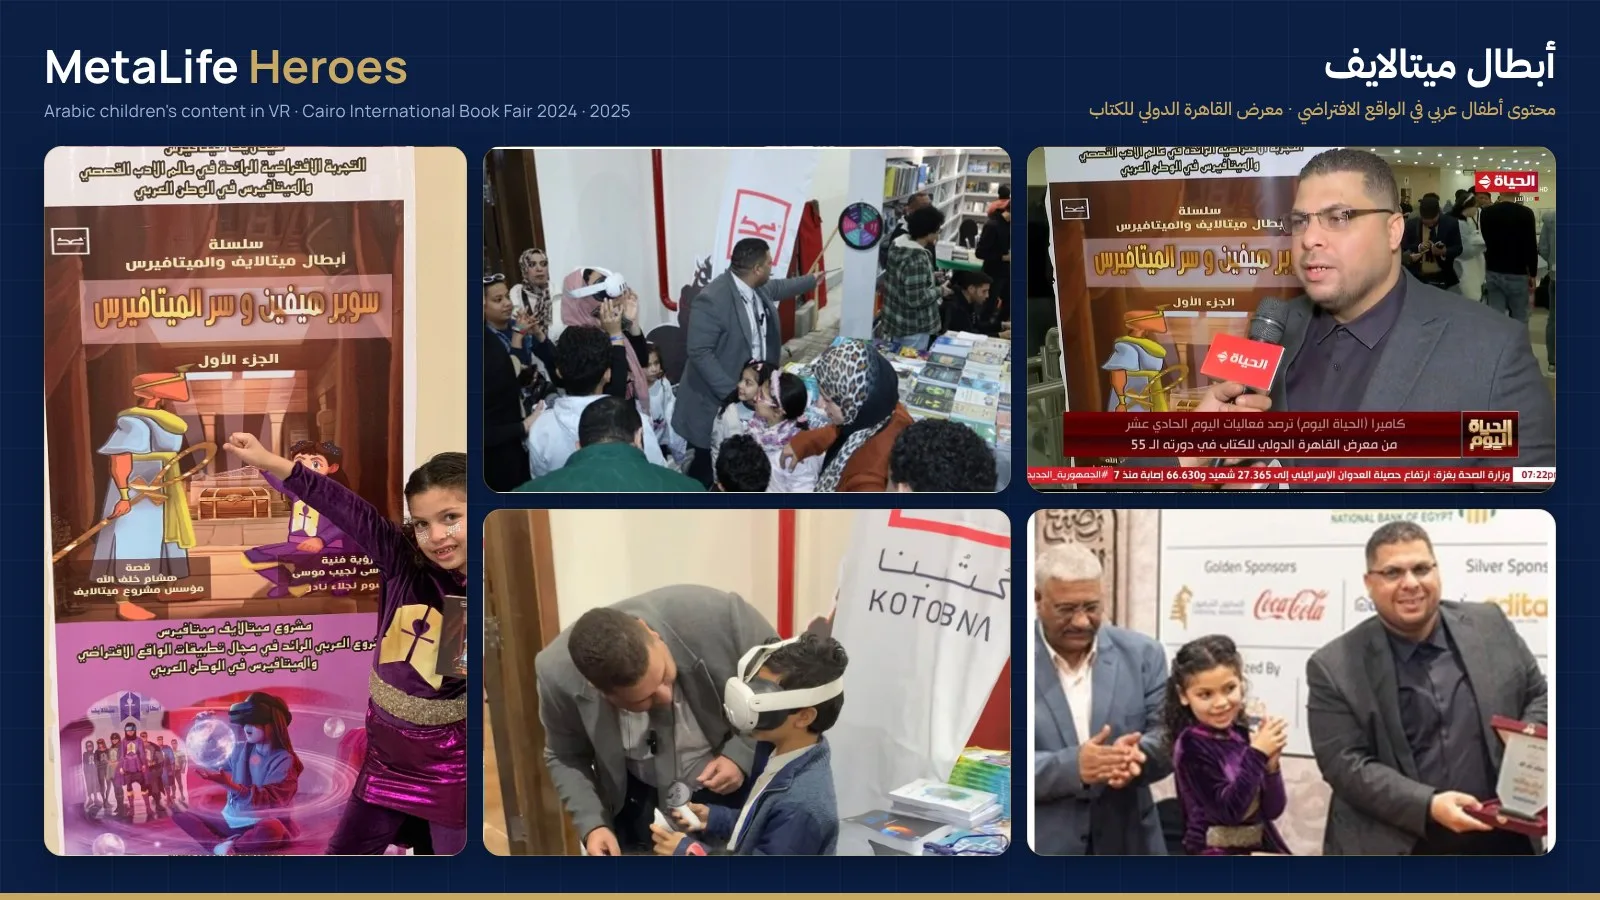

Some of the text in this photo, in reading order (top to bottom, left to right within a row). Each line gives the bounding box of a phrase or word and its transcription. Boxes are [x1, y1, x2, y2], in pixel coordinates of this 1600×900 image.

[79, 161, 131, 182] القصصي
[167, 160, 195, 178] عالم
[196, 160, 216, 180] في
[218, 159, 258, 176] الرائدة
[261, 158, 322, 177] الافتراضية
[324, 157, 366, 175] التجربة
[1120, 158, 1260, 178] والميتافيرس في الوطن العربي
[134, 178, 313, 201] والميتافيرس في الوطن العربي
[1179, 205, 1221, 216] سلسلة
[1116, 219, 1284, 233] بطال ميتالايف والميتافيرس
[208, 237, 263, 250] سلسلة
[126, 252, 346, 271] أبطال ميتالايف والميتافيرس
[1094, 243, 1175, 276] الميتافيرس
[1177, 249, 1199, 276] سر
[1204, 249, 1215, 276] و
[94, 284, 381, 328] سوبر هيفين و سر الميتافيرس
[1173, 296, 1235, 308] الجزء الأول
[198, 352, 279, 369] الجزء الأول
[1229, 352, 1269, 370] الحياة
[1331, 511, 1453, 523] NATIONAL BANK OF EGYPT
[125, 563, 150, 572] قصة
[321, 555, 346, 566] فنية
[1204, 560, 1297, 575] Golden Sponsors
[1466, 558, 1503, 573] Silver
[118, 575, 140, 584] خلف
[144, 573, 177, 585] هشام
[292, 569, 325, 579] موسى
[329, 567, 356, 577] نجيب
[73, 584, 204, 598] مؤسس مشروع ميتالايف
[1484, 592, 1548, 617] dita
[157, 619, 313, 639] مشروع ميتالايف ميتافيرس
[136, 643, 172, 660] الواقع
[173, 641, 225, 658] تطبيقات
[227, 641, 256, 656] مجال
[260, 640, 279, 655] في
[282, 638, 312, 653] الرائد
[315, 636, 350, 653] العربي
[77, 644, 134, 663] الافتراضي
[150, 657, 318, 679] والميتافيرس في الوطن العربي
[1266, 661, 1281, 676] By
